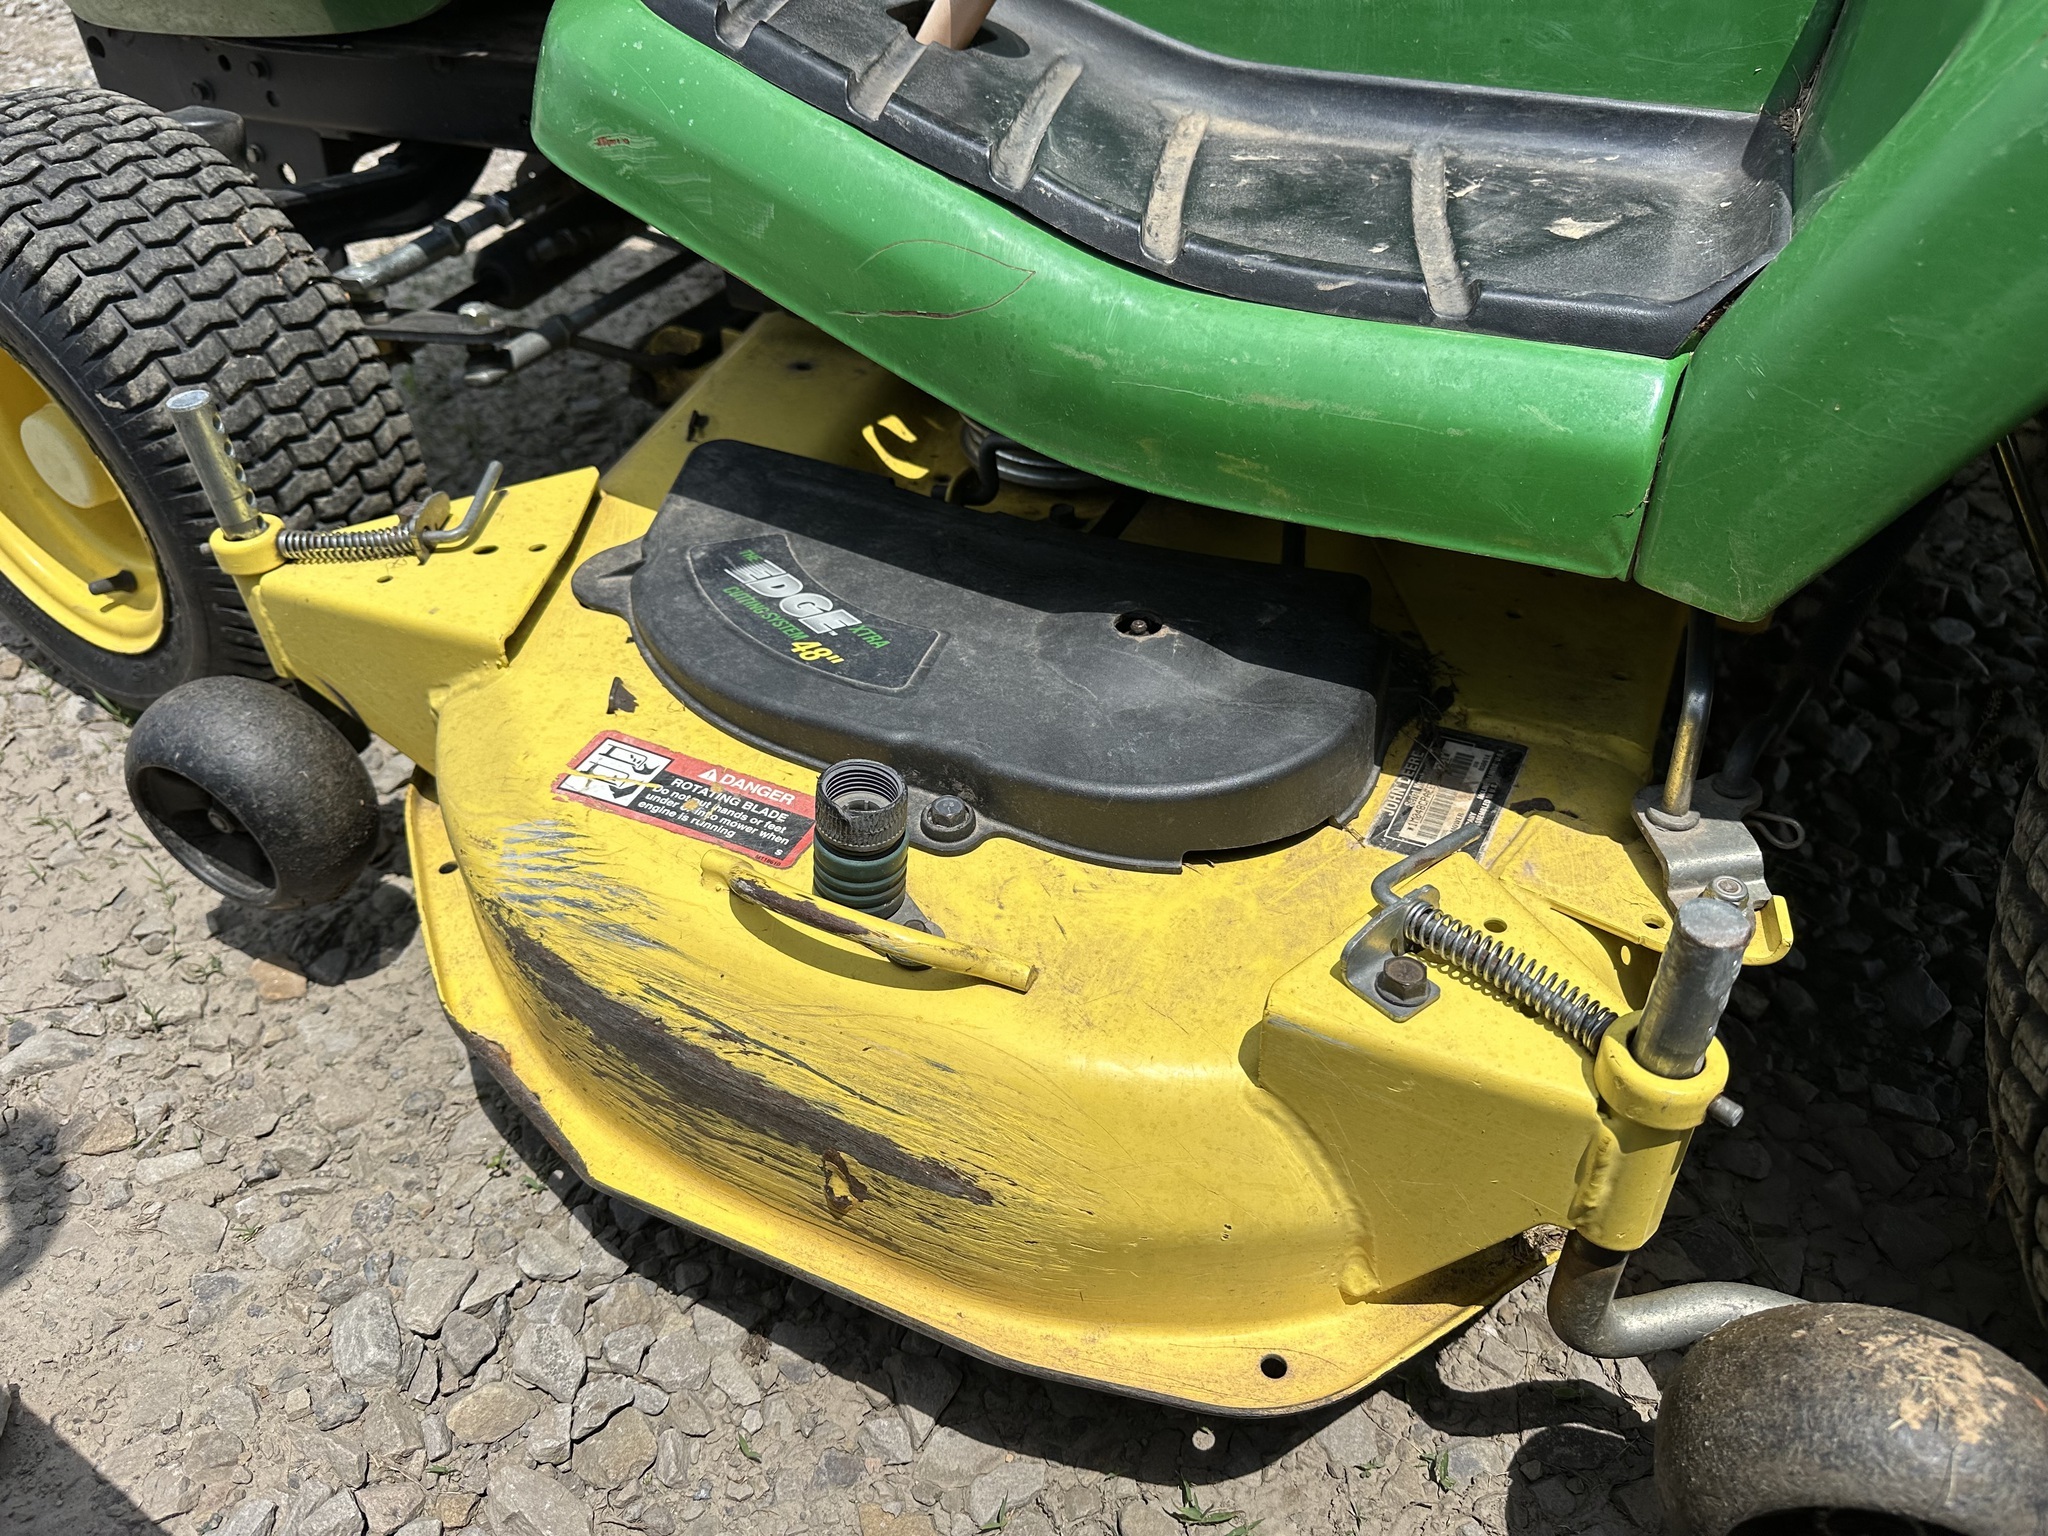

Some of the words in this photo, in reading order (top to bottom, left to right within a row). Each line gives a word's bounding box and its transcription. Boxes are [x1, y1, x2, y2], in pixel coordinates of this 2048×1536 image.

[740, 550, 764, 562] THE
[722, 586, 770, 615] CUTTING
[761, 612, 809, 640] SYSTEM
[724, 559, 862, 635] EDGE
[850, 625, 890, 649] XTRA
[791, 641, 844, 664] 48"
[670, 777, 740, 807] ROTATING
[742, 800, 789, 823] BLADE
[720, 774, 796, 805] DANGER
[1384, 785, 1404, 816] JOHN
[1398, 749, 1425, 786] DEERE
[638, 801, 677, 817] engine
[677, 813, 689, 821] is
[690, 817, 736, 839] running
[645, 793, 680, 808] under
[719, 818, 759, 834] mower
[759, 830, 790, 845] when
[652, 784, 669, 794] Do
[670, 792, 691, 801] not
[712, 803, 748, 821] hands
[750, 817, 762, 826] or
[764, 820, 787, 834] feet
